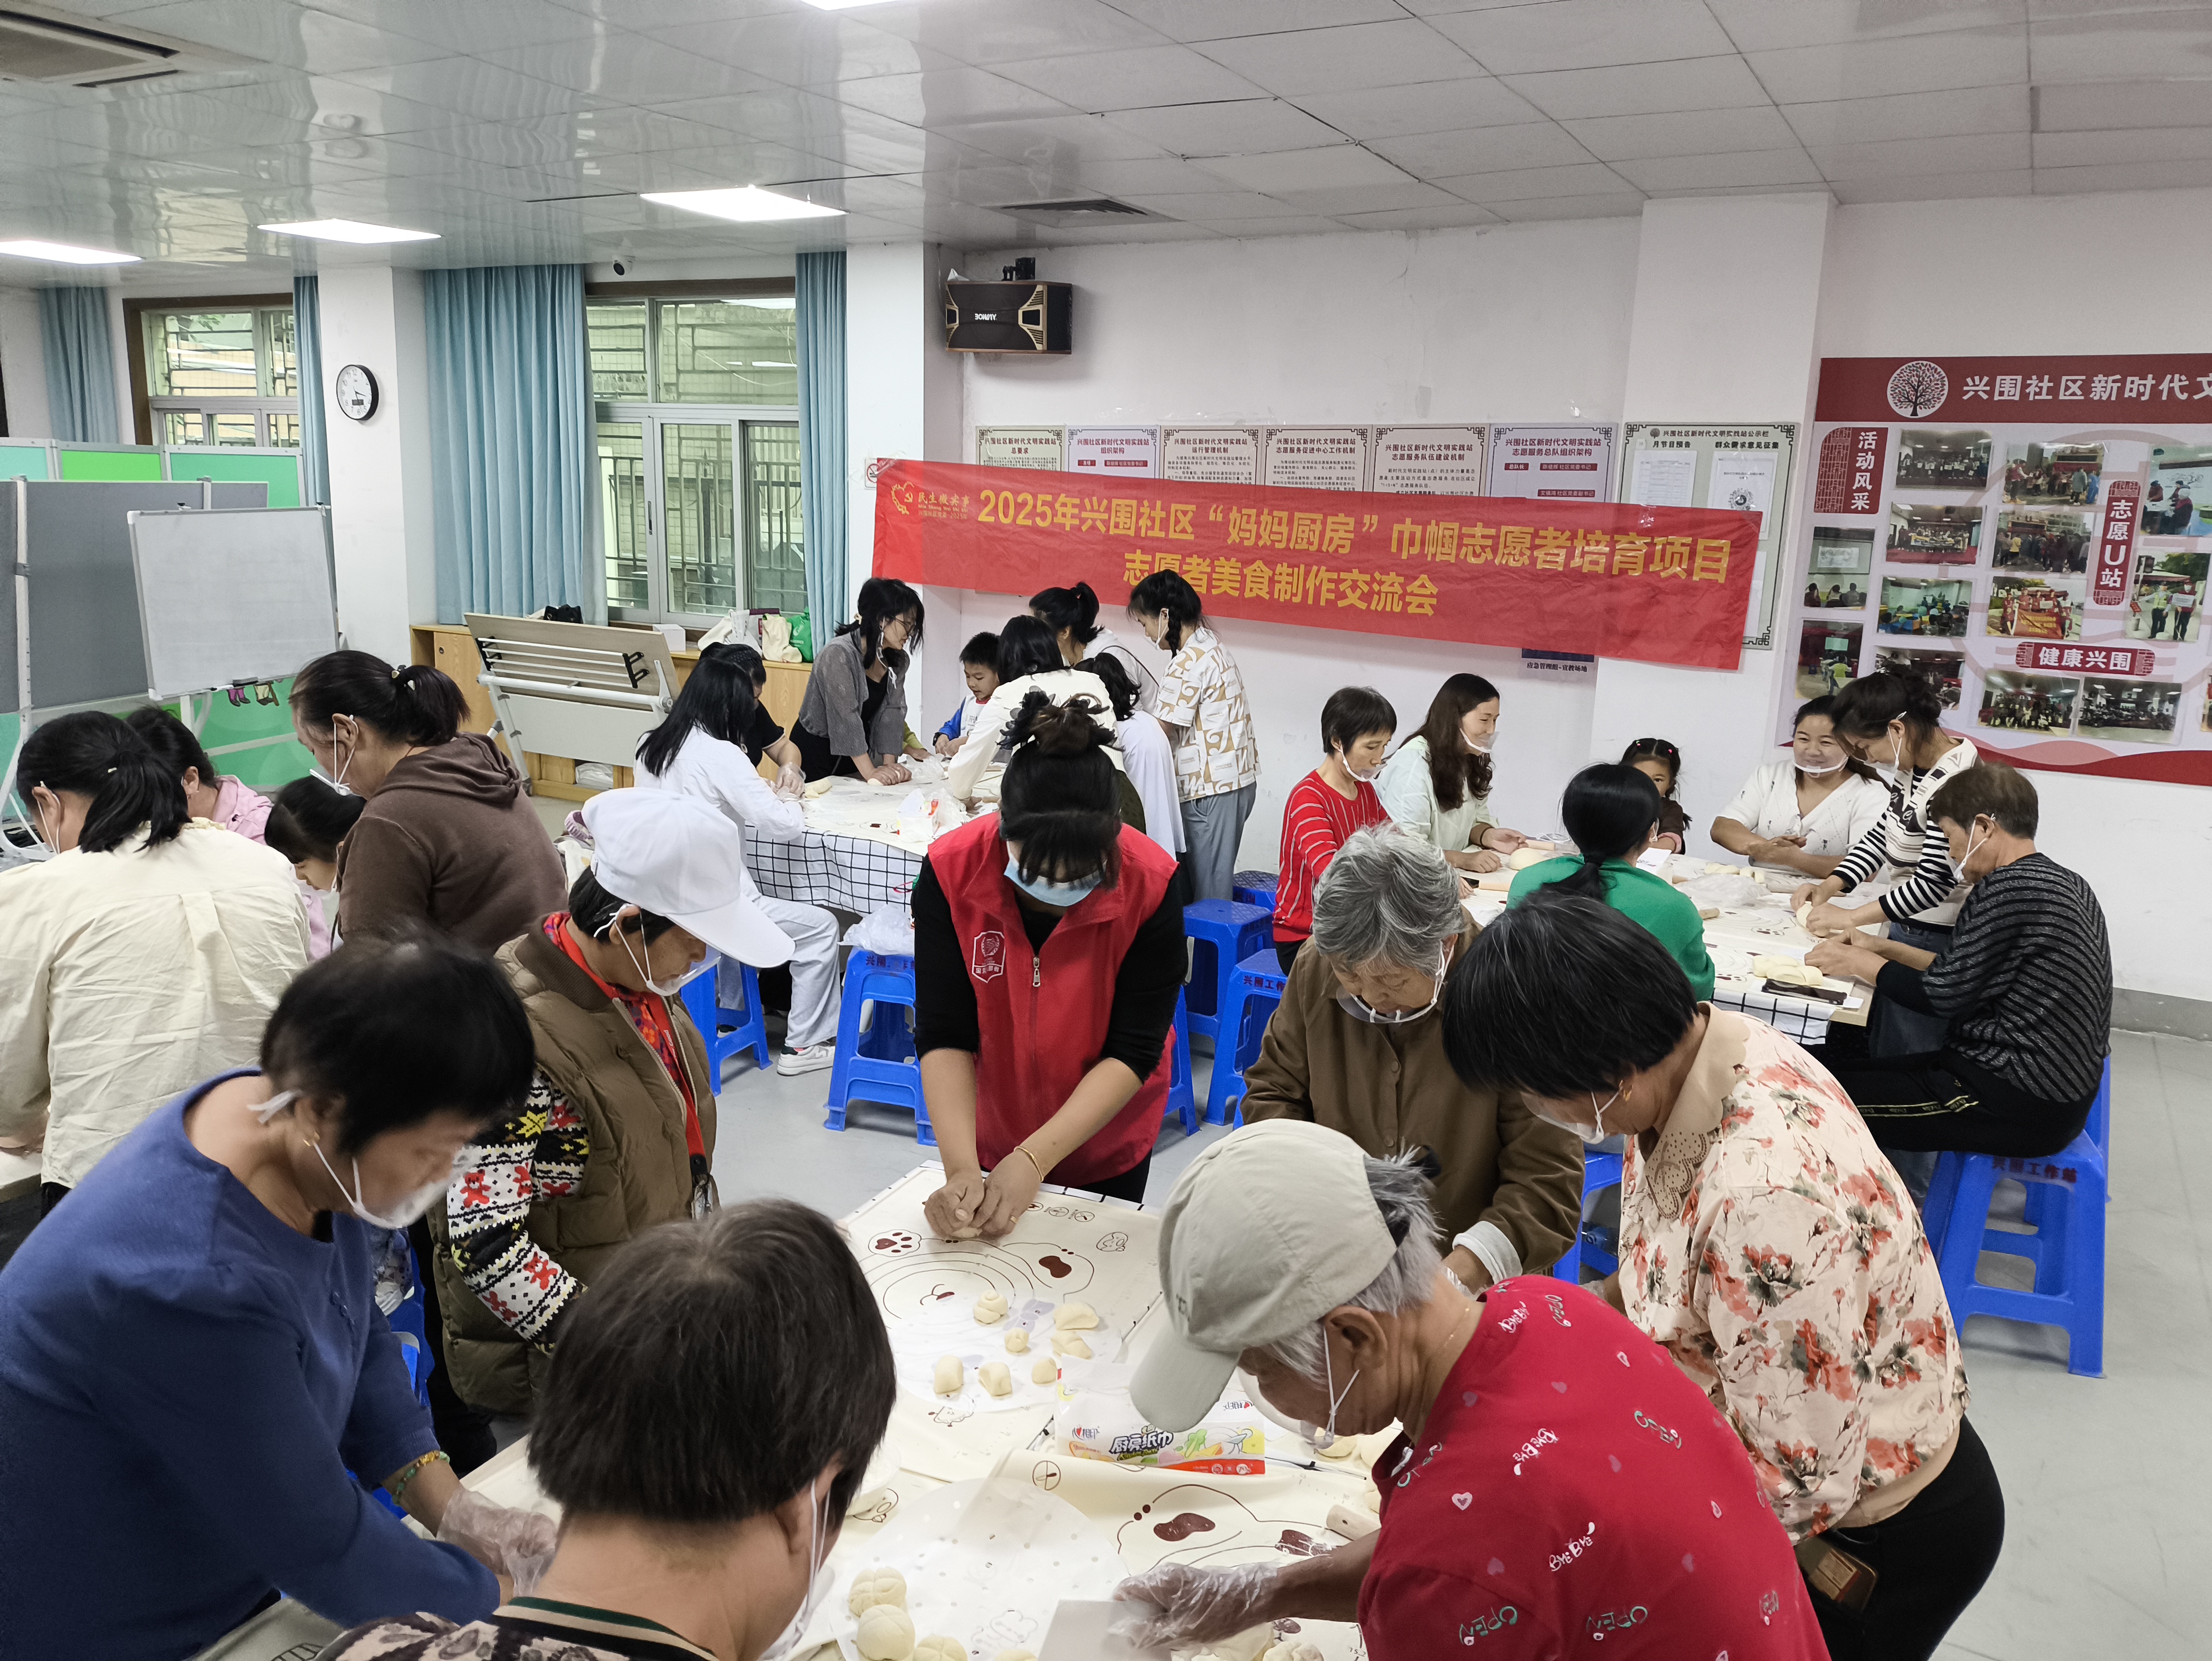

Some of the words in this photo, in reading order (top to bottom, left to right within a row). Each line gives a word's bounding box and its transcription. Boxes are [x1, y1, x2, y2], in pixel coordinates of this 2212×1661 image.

[1962, 373, 2212, 401] 兴围社区新时代文
[1505, 438, 1602, 446] 兴围社区新时代文明实践站
[1512, 448, 1593, 456] 志愿服务总队组织架构
[1392, 453, 1465, 461] 志愿服务队伍建设机制
[1850, 431, 1878, 511] 活动风采
[2100, 499, 2133, 588] 志愿U站
[2038, 647, 2132, 671] 健康兴围
[1108, 1430, 1174, 1454] 厨房纸巾
